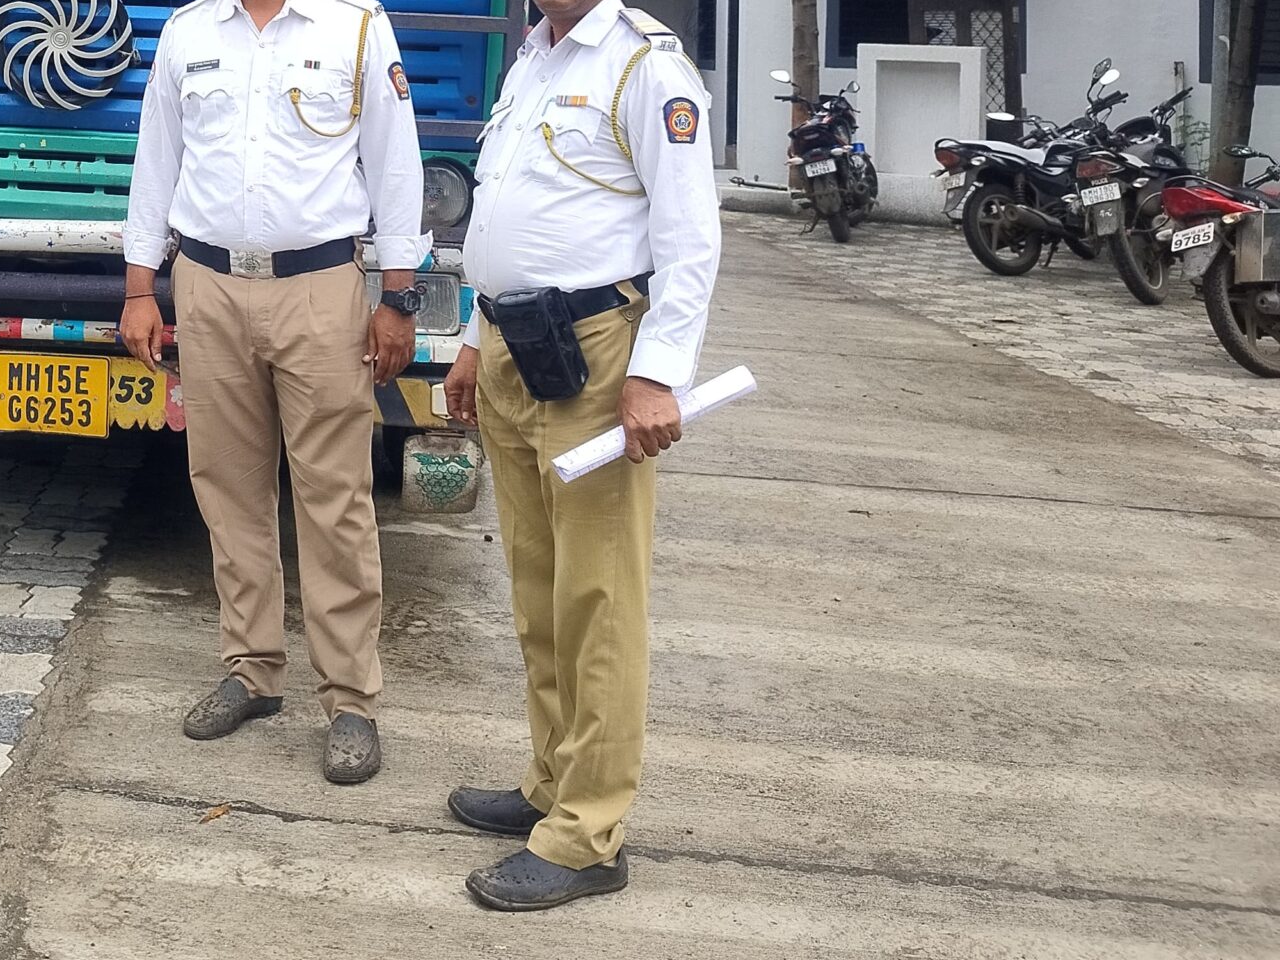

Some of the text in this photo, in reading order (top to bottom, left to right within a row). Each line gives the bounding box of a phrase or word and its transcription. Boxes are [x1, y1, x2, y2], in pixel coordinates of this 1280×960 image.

[1173, 231, 1211, 250] 9785
[7, 361, 91, 395] MH15E
[7, 395, 93, 428] G6253
